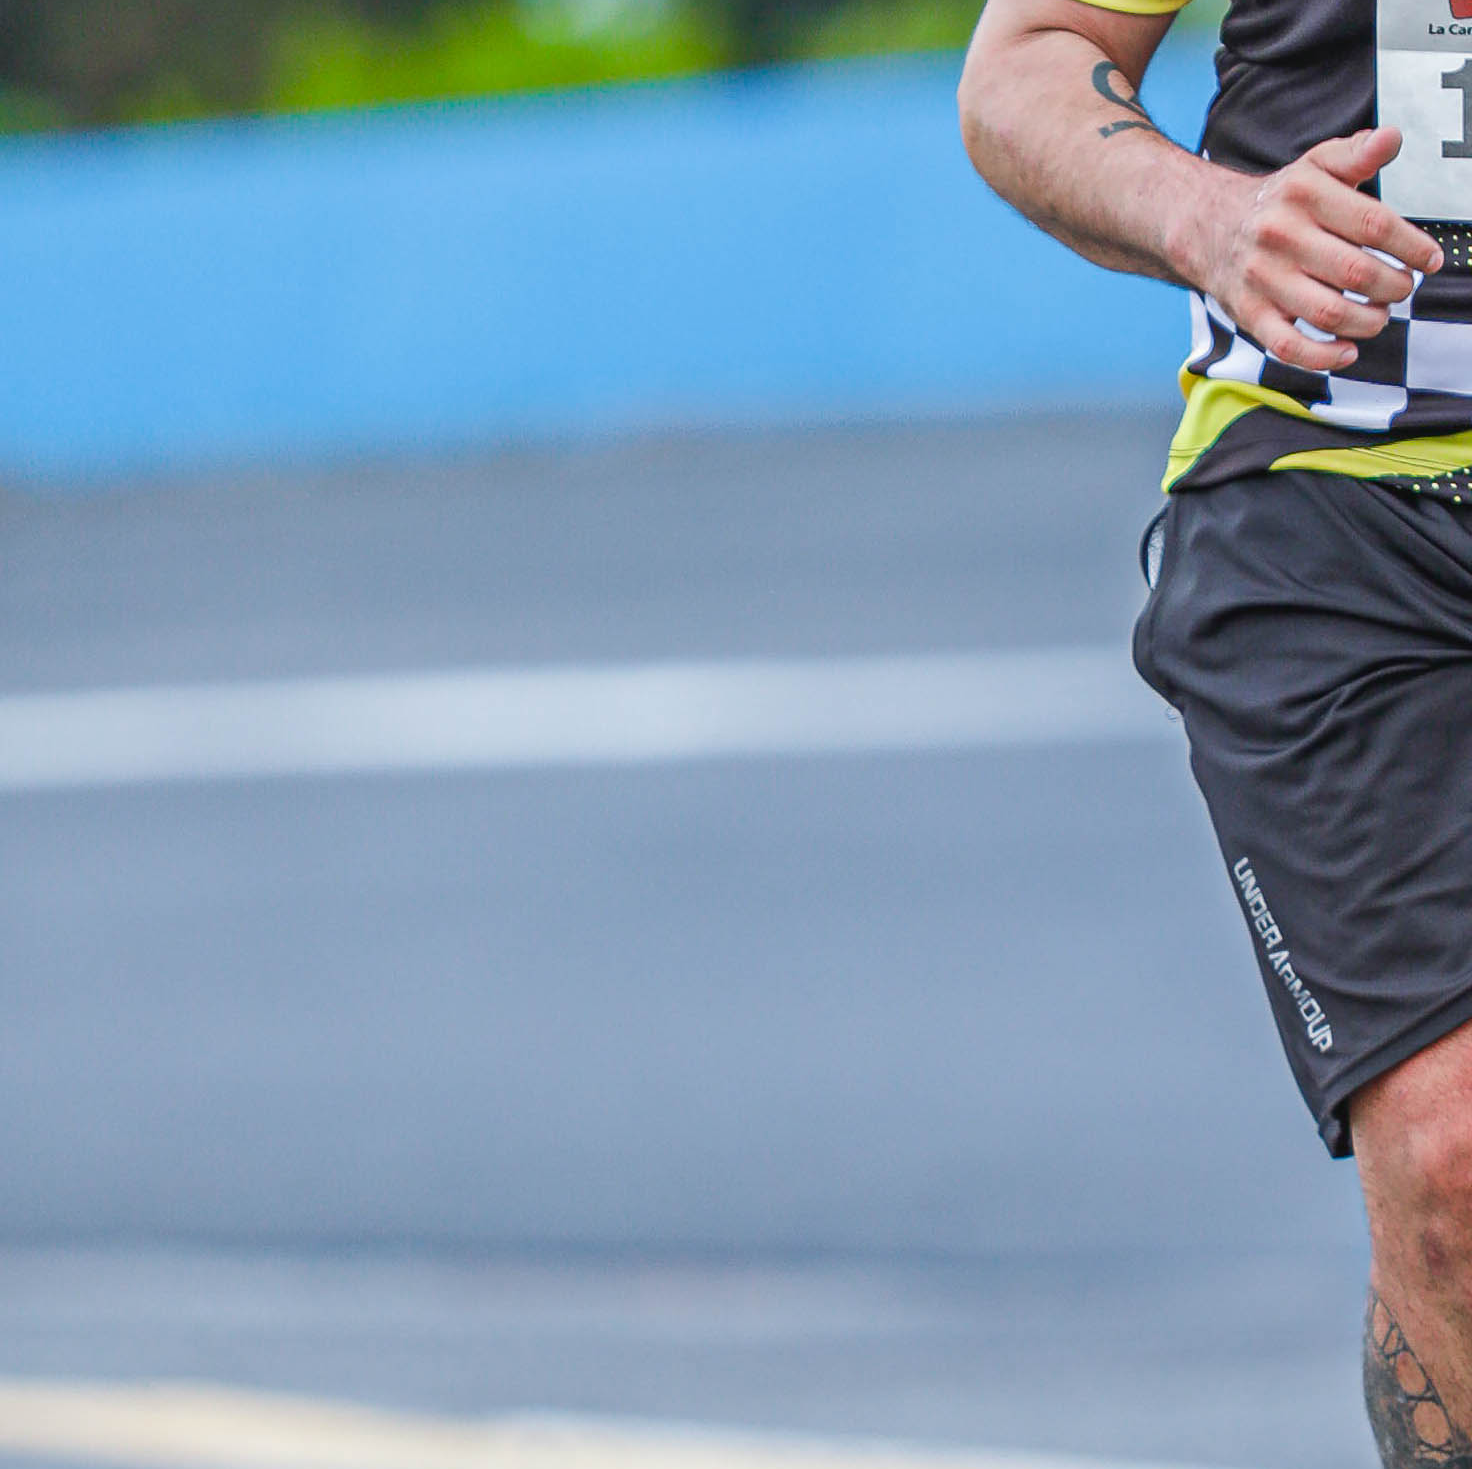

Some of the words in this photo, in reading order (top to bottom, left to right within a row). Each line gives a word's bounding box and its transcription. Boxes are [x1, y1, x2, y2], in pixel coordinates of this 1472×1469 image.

[1428, 23, 1445, 35] La
[1233, 856, 1283, 949] UNDER
[1268, 949, 1333, 1053] ARMOUR
